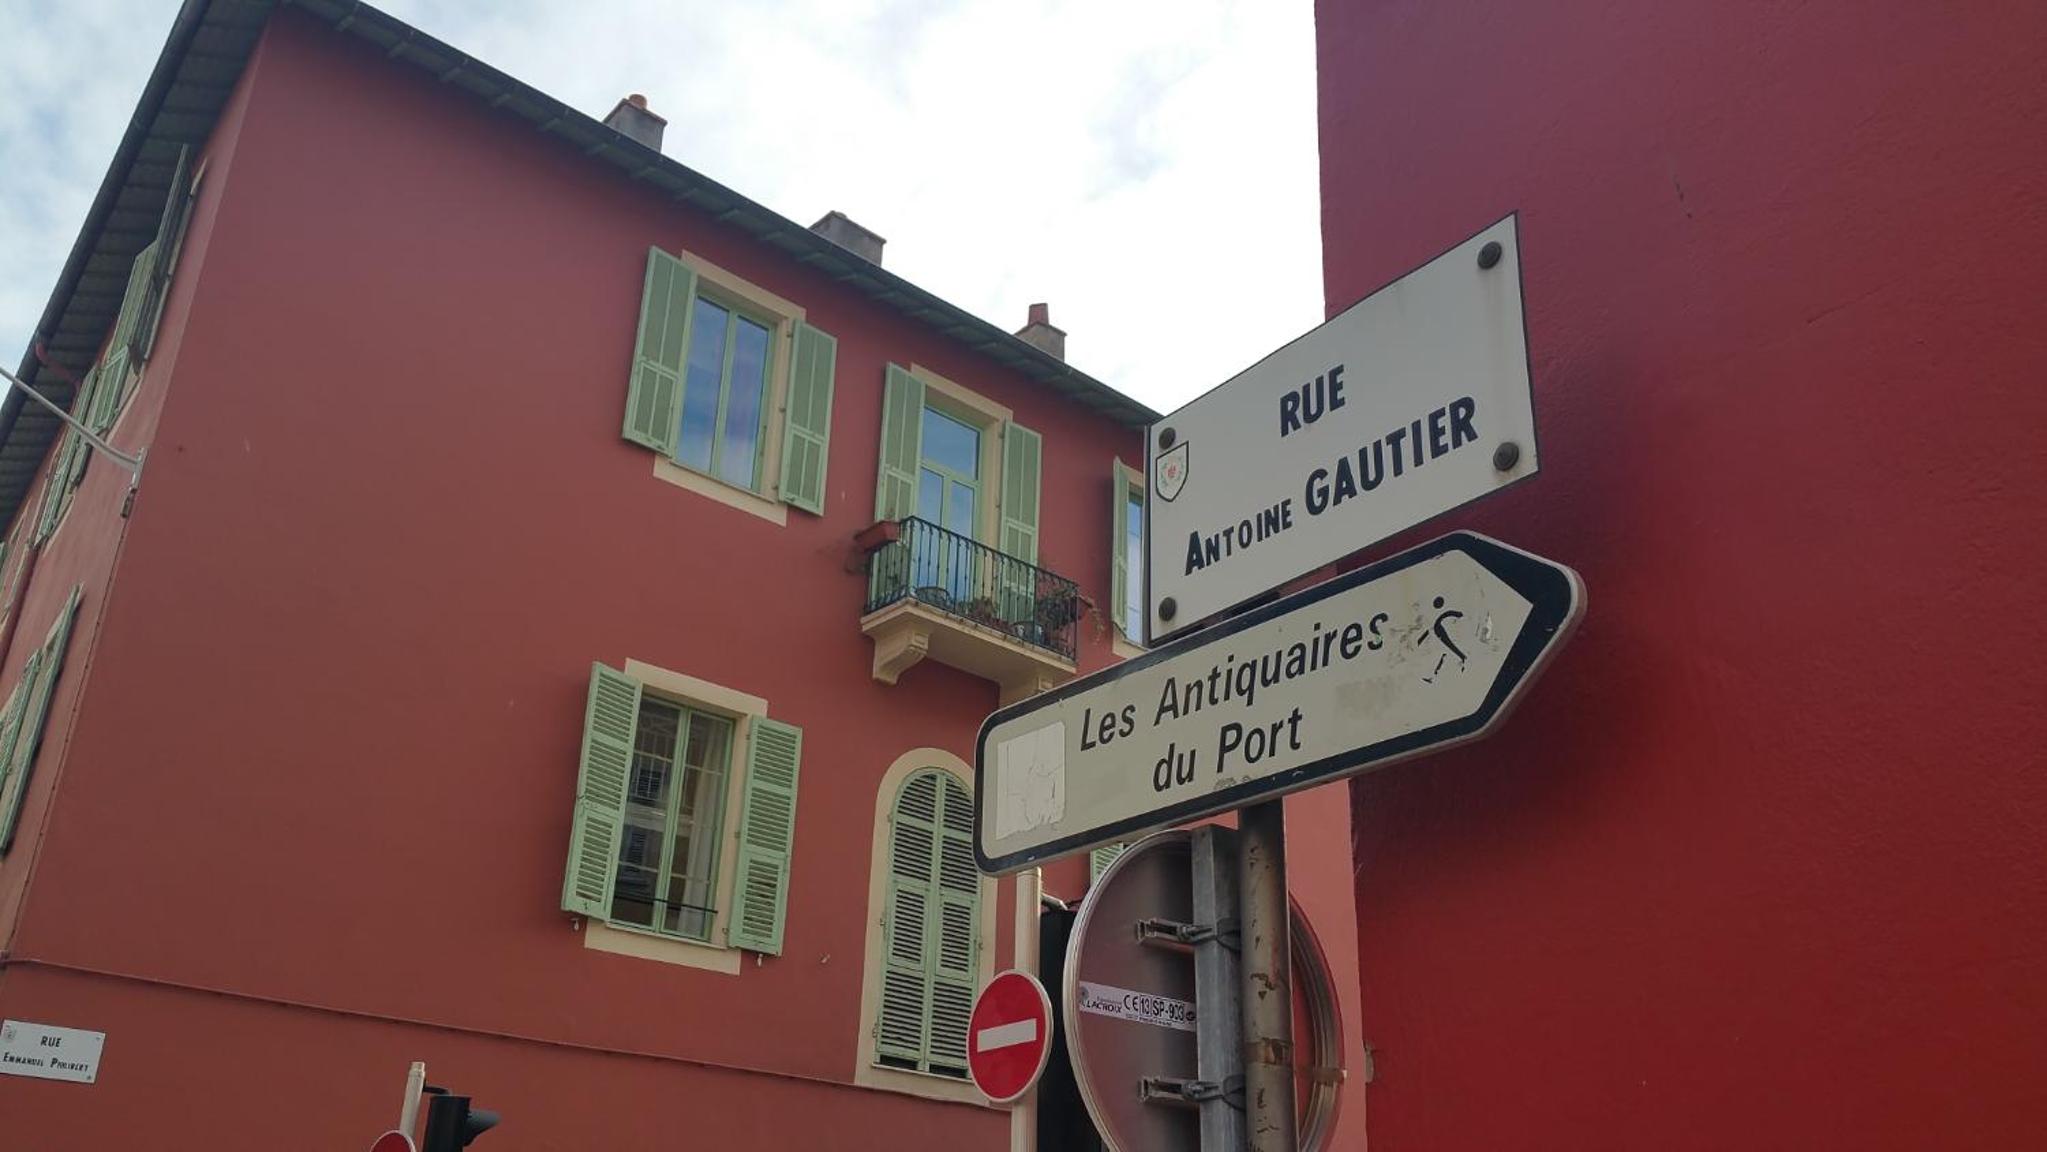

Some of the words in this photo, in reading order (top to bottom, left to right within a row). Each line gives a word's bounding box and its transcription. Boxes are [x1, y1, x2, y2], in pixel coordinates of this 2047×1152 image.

[1279, 364, 1346, 437] RUE
[1184, 498, 1292, 576] ANTOINE
[1305, 396, 1479, 516] GAUTIER
[1079, 703, 1137, 752] Les
[1153, 612, 1389, 726] Antiquaires
[1152, 743, 1196, 793] du
[1216, 706, 1304, 773] Port
[3, 1051, 44, 1067] EMMANUEL
[50, 1057, 89, 1072] PHILIBERT
[40, 1035, 62, 1048] RUE
